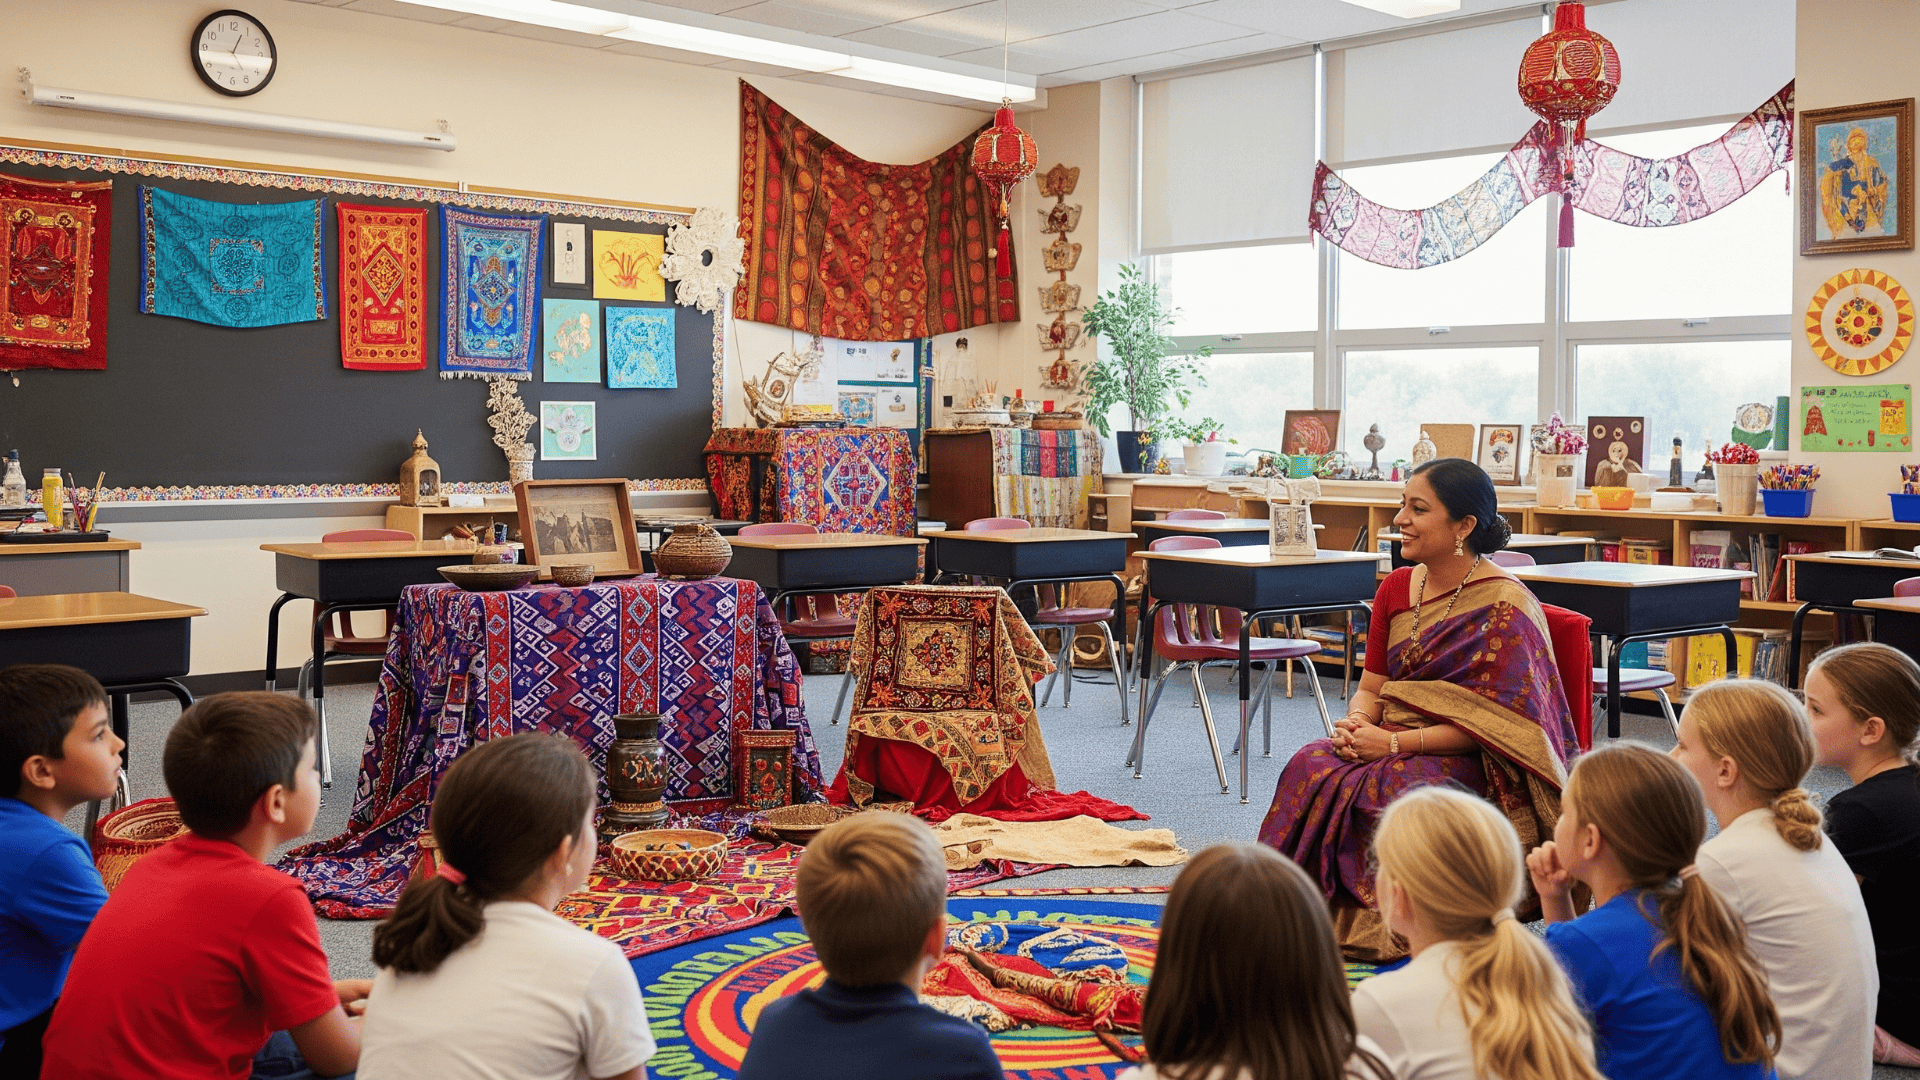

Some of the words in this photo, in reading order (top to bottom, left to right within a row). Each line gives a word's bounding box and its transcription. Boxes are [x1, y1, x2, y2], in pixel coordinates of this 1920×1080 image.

[218, 23, 224, 32] 11
[230, 22, 238, 31] 12
[207, 31, 216, 40] 10
[254, 38, 260, 47] 2
[217, 71, 222, 80] 7
[230, 76, 235, 85] 6
